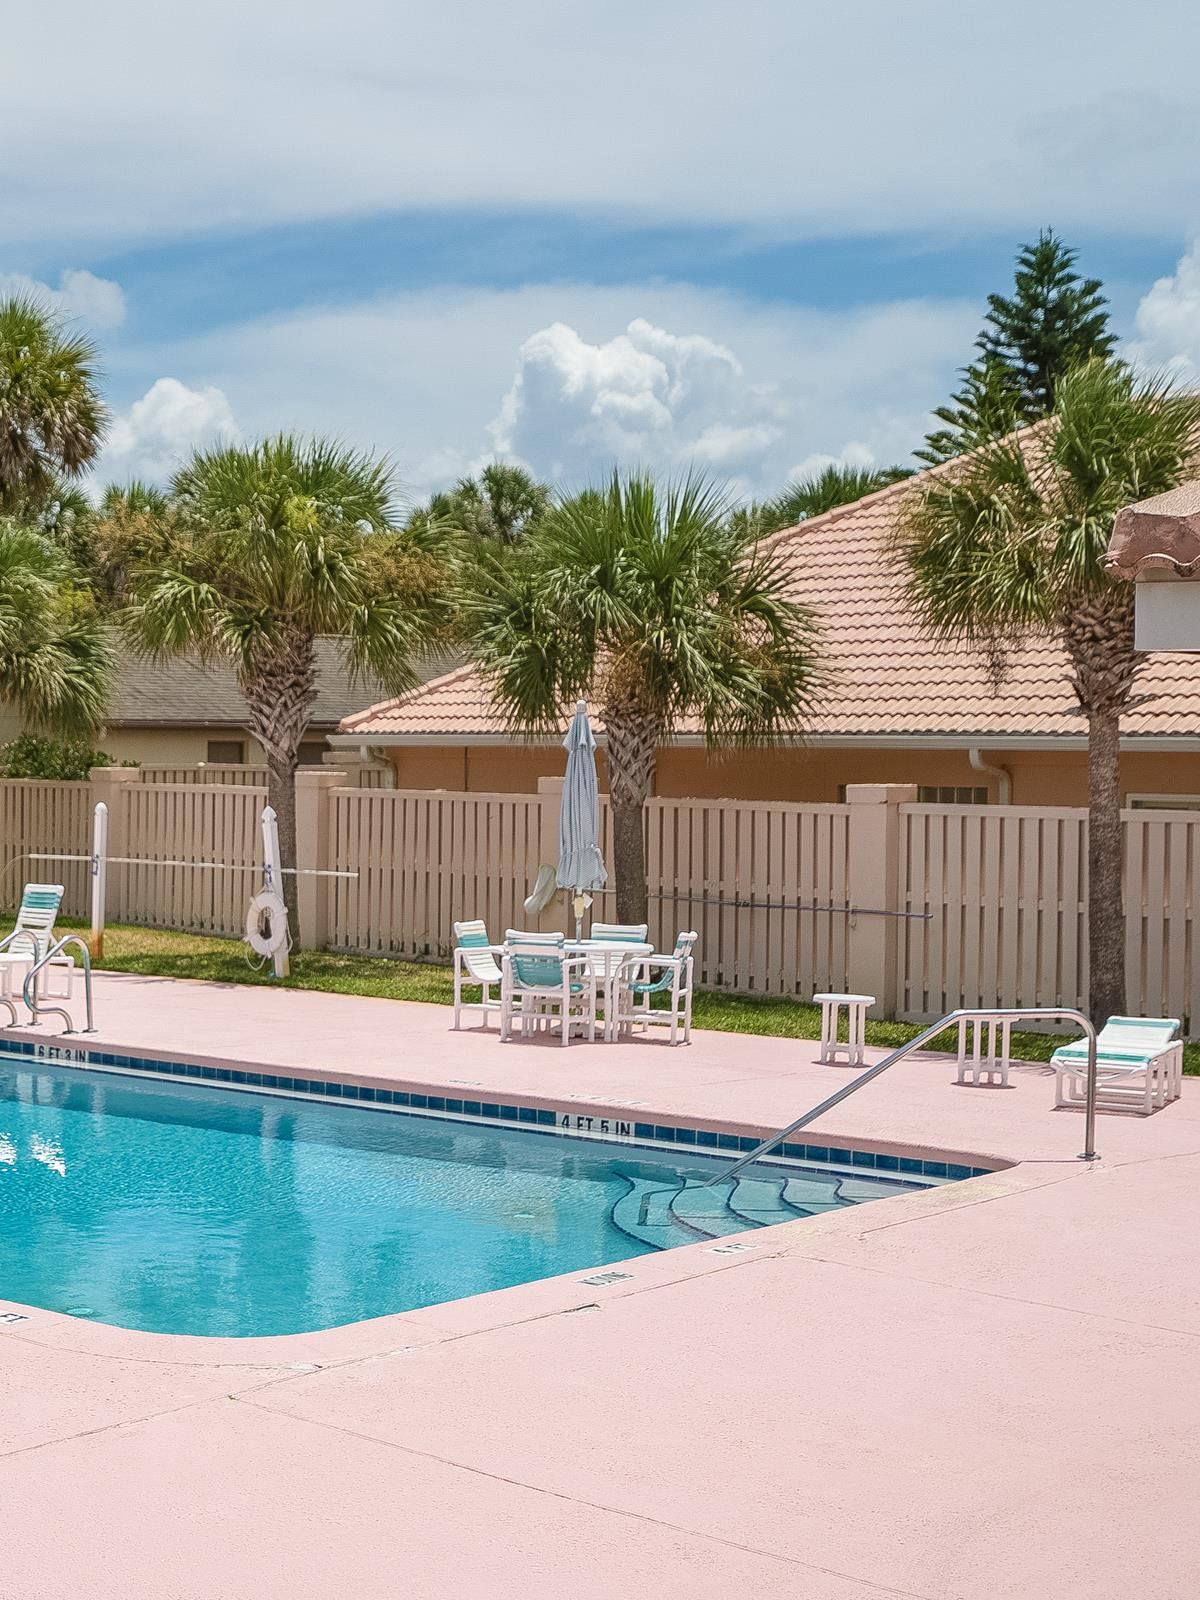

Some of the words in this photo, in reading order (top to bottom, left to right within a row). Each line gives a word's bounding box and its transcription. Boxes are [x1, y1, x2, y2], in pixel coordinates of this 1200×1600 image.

[38, 1045, 45, 1057] 6
[48, 1046, 62, 1059] FT
[64, 1049, 72, 1061] 3
[75, 1049, 86, 1062] IN
[561, 1114, 570, 1129] 4
[576, 1116, 594, 1132] FT
[600, 1119, 609, 1134] 5
[615, 1121, 631, 1136] IN
